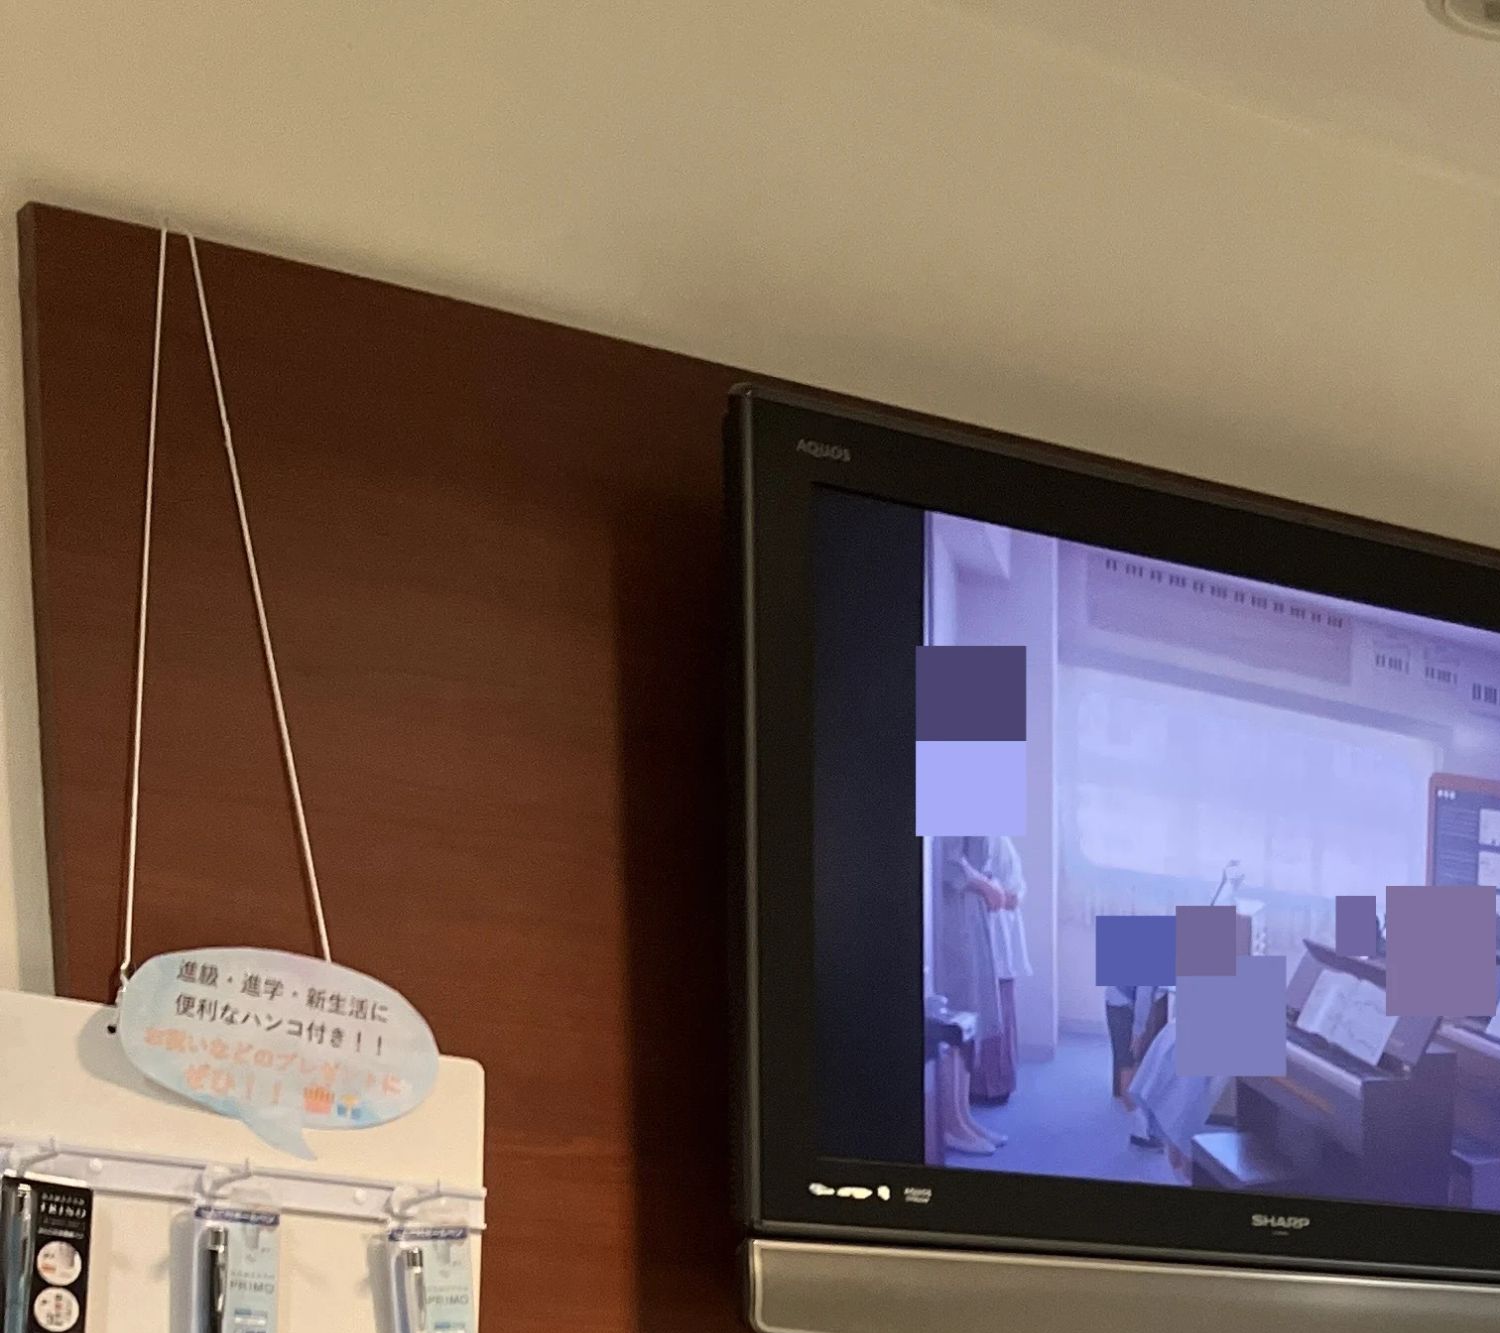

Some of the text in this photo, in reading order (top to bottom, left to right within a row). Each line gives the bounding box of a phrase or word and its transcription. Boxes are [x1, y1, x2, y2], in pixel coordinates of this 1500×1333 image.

[176, 957, 390, 1025] 進級・進学・新生活に
[175, 993, 384, 1057] 便利なハンコ付き！！
[1251, 1213, 1311, 1230] SHARP
